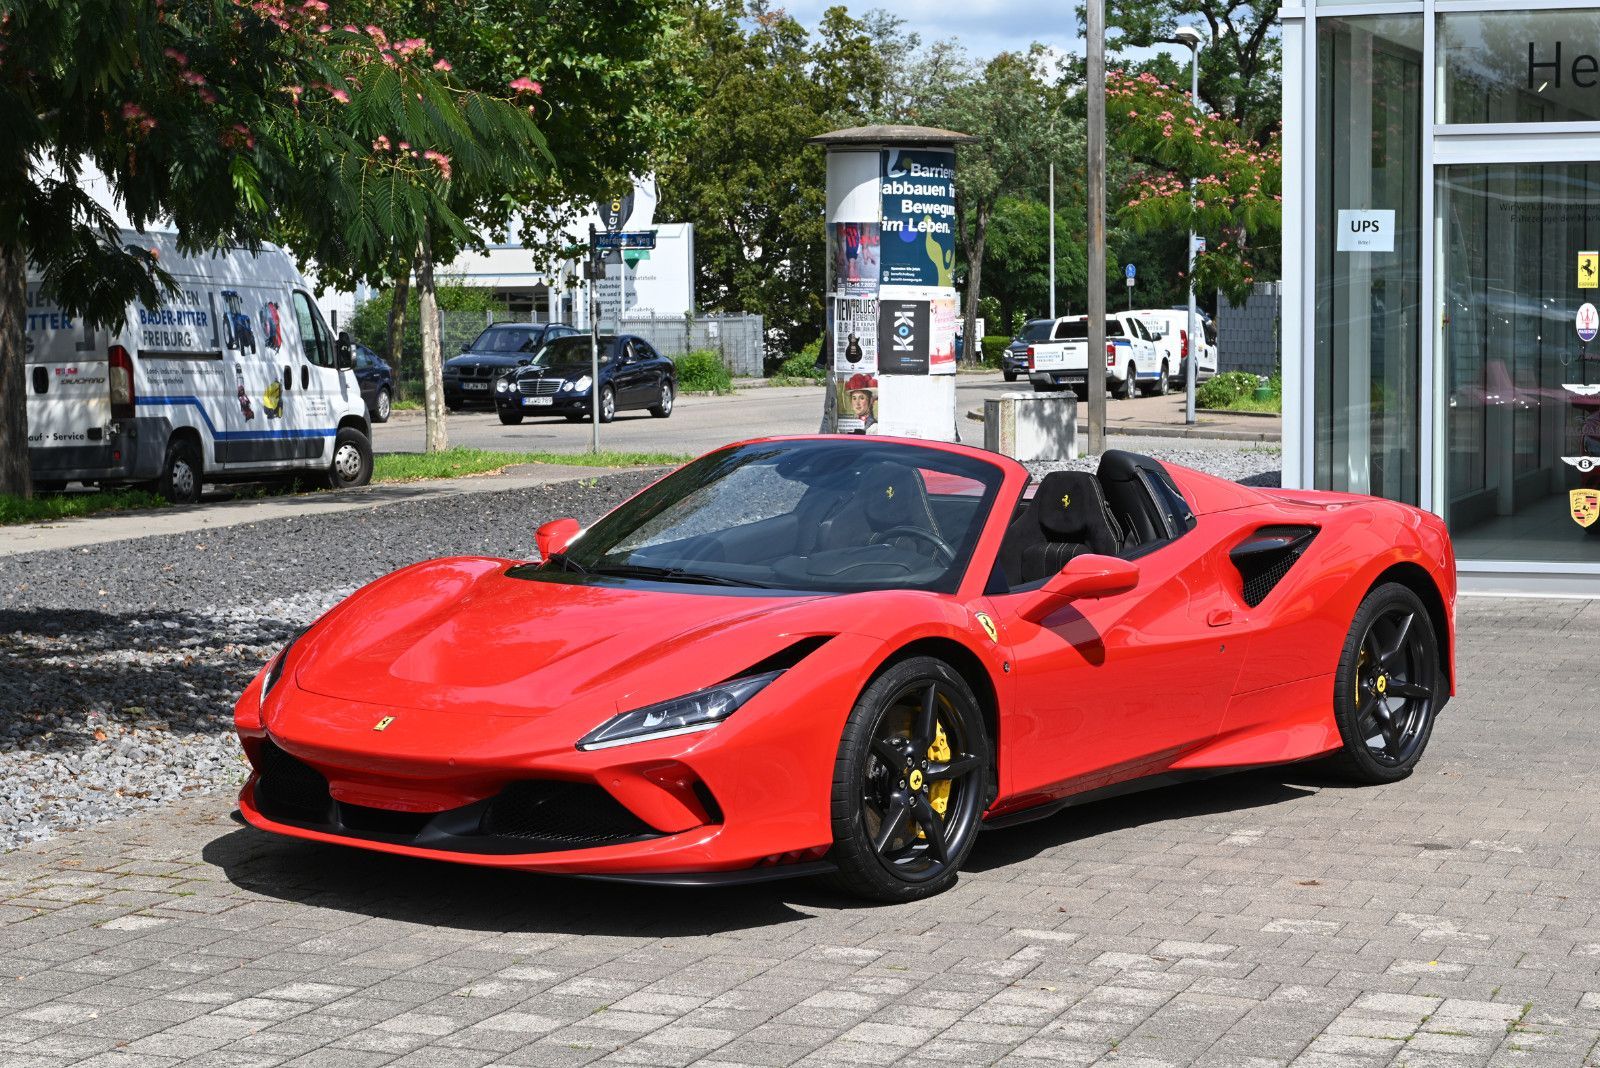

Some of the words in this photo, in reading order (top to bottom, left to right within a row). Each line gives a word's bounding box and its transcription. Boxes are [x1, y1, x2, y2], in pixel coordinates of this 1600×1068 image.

[1528, 41, 1599, 89] He
[882, 181, 946, 197] abbauen
[881, 216, 903, 232] im
[908, 217, 951, 234] Leben.
[1351, 220, 1379, 233] UPS
[140, 309, 208, 327] BADER-RITTER
[837, 299, 852, 320] NEW
[855, 299, 876, 314] BLUES
[142, 330, 192, 348] FREIBURG
[53, 432, 85, 441] Service
